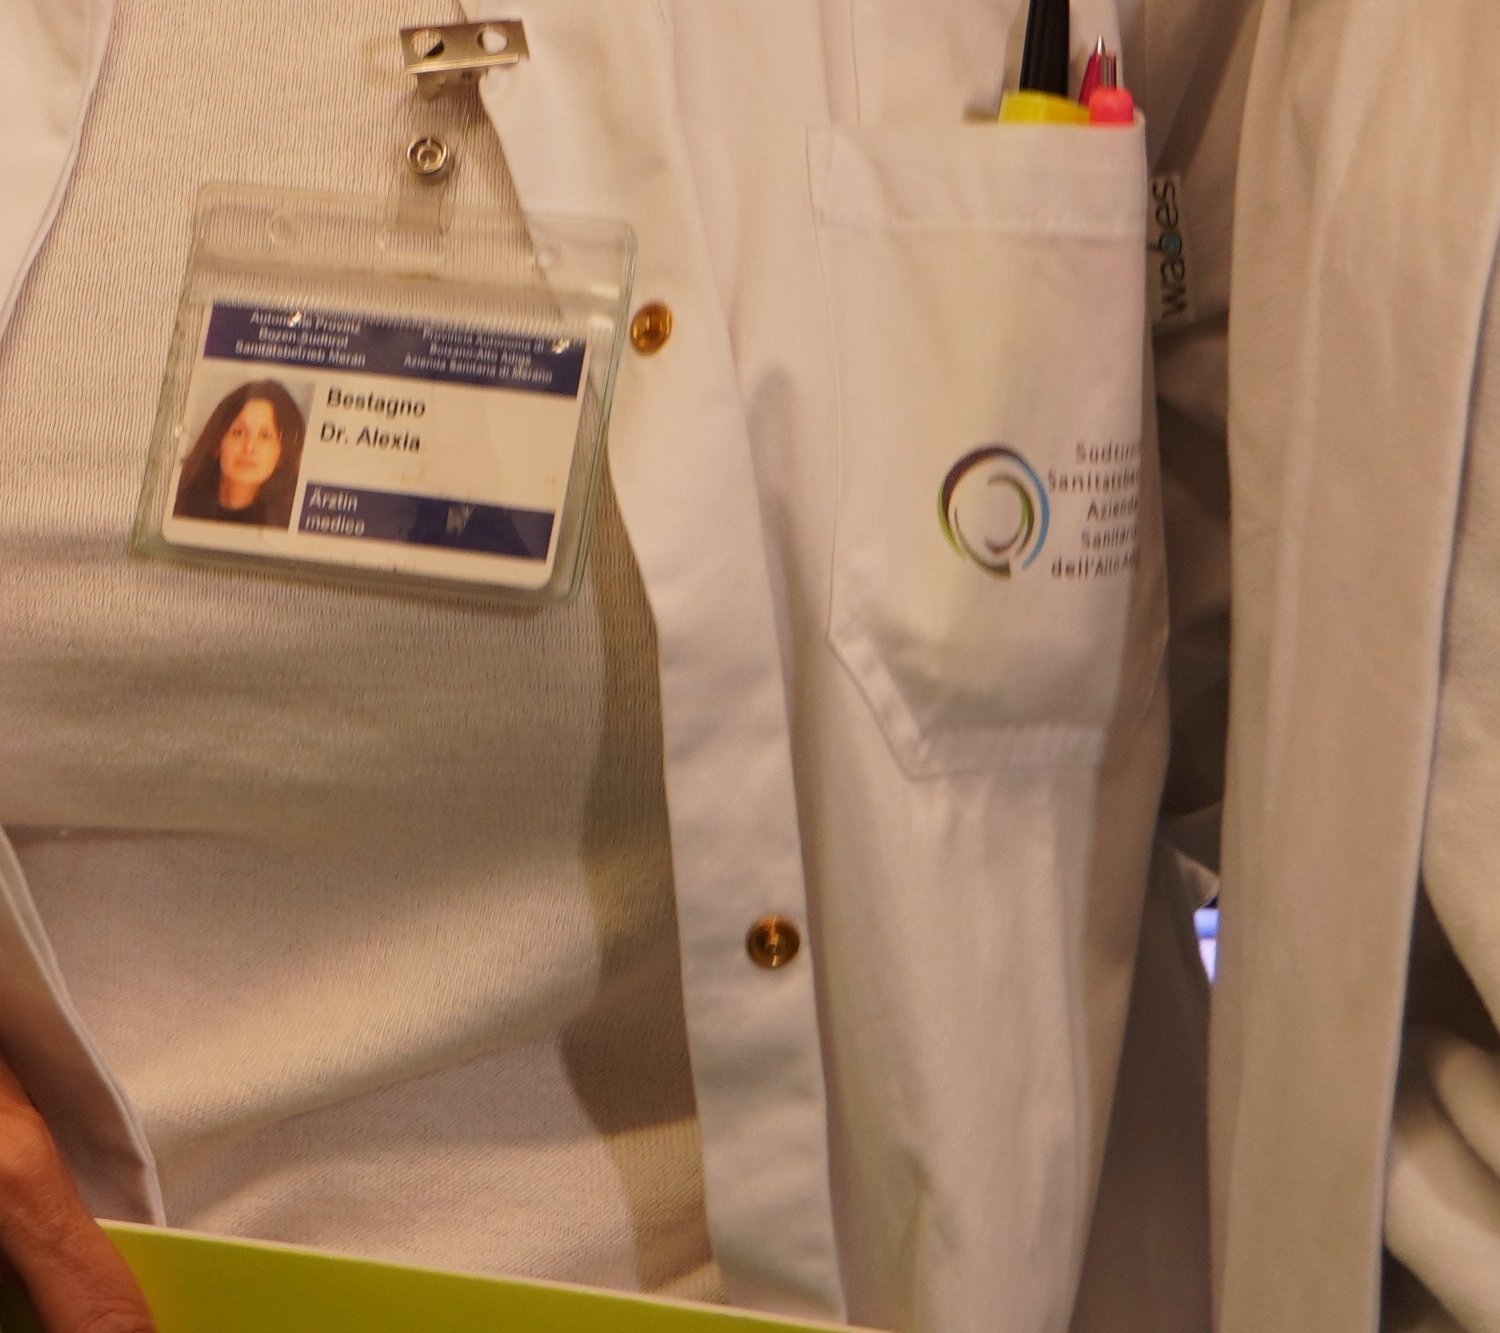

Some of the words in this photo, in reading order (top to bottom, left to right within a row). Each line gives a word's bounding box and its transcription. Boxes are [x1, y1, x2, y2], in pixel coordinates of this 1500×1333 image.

[1147, 180, 1187, 320] wabes
[326, 386, 426, 420] Bestagno
[320, 420, 348, 445] Dr.
[356, 424, 421, 453] Alexia
[305, 513, 365, 536] medico
